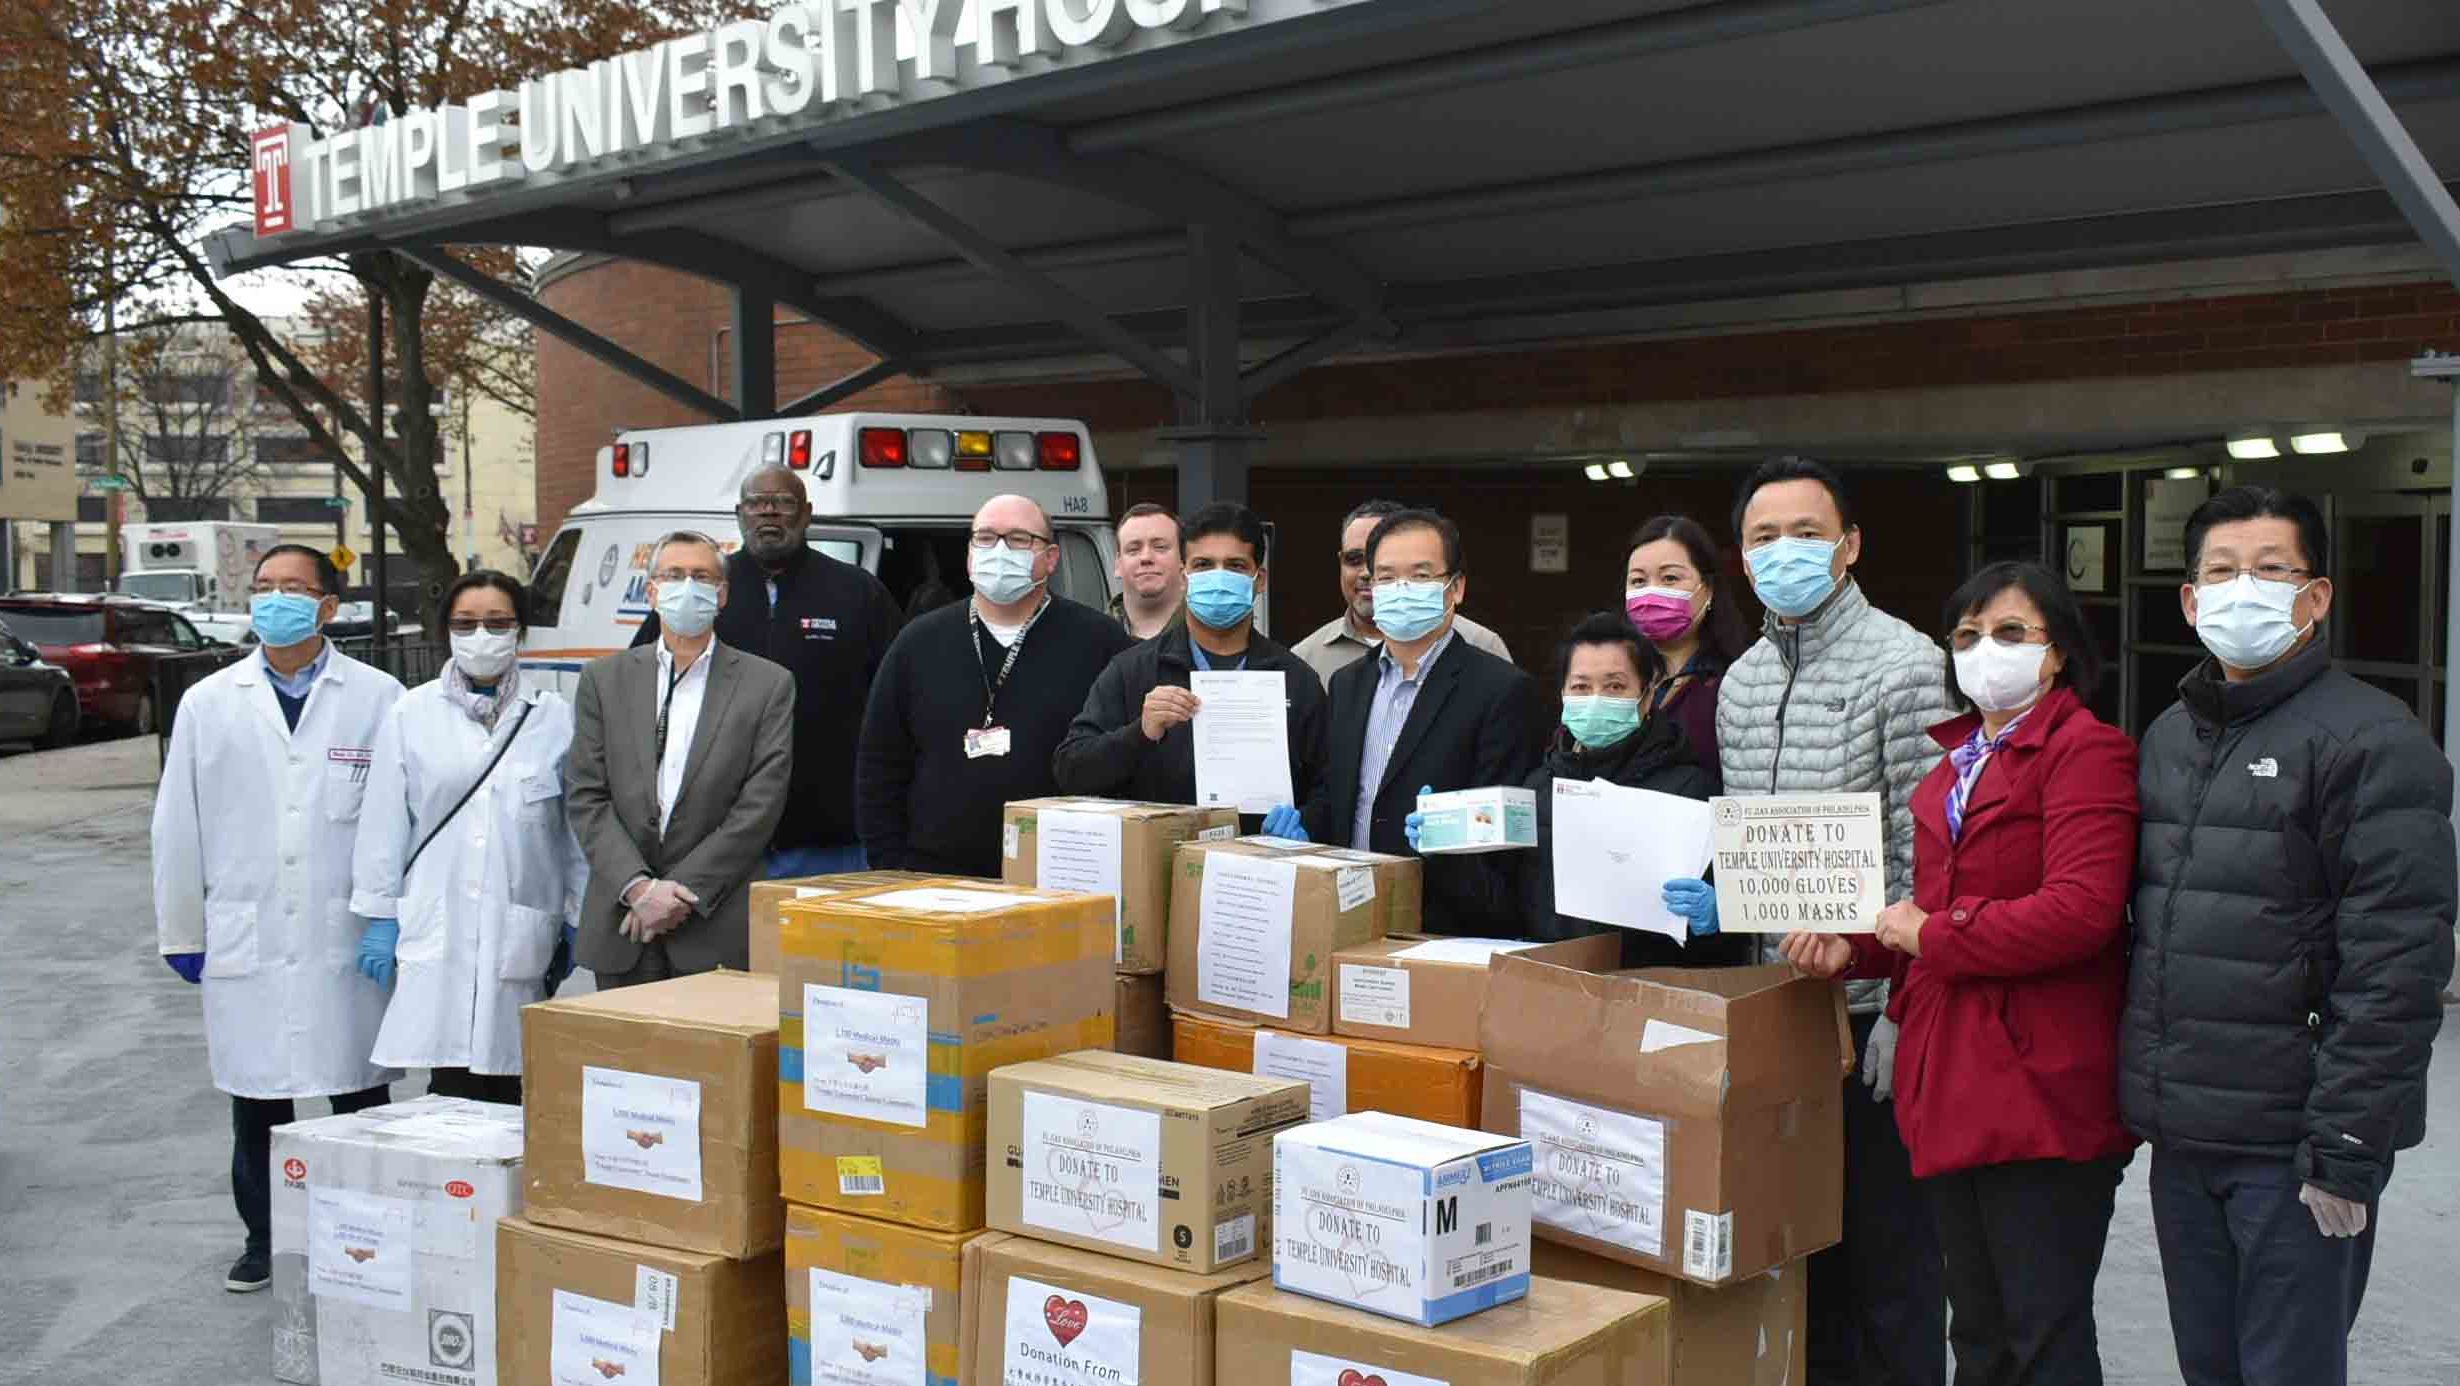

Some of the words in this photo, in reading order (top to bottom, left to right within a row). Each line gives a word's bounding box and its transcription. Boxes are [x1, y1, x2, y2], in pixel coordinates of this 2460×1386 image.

[302, 90, 512, 222] TEMPLE
[519, 0, 963, 172] UNIVERSITY
[1746, 824, 1815, 843] DONATE
[1824, 823, 1845, 842] TO
[1719, 851, 1758, 870] TEMPLE
[1761, 848, 1821, 870] UNIVERSITY
[1825, 849, 1876, 868] HOSPITAL
[1739, 877, 1789, 896] 10,000
[1795, 876, 1857, 894] GLOVES
[1743, 903, 1789, 921] 1,000
[1797, 902, 1858, 921] MASKS
[1059, 1155, 1101, 1180] DONATE
[1104, 1164, 1119, 1182] TO
[1558, 1153, 1602, 1183] DONATE
[1606, 1166, 1620, 1186] TO
[1030, 1181, 1059, 1203] TEMPLE
[1061, 1187, 1106, 1214] UNIVERSITY
[1107, 1197, 1147, 1222] HOSPITAL
[1436, 1196, 1457, 1235] M
[1532, 1178, 1556, 1200] EMPLE
[1560, 1183, 1606, 1214] UNIVERSITY
[1609, 1196, 1651, 1225] HOSPITAL
[1179, 1230, 1186, 1241] S
[1319, 1211, 1362, 1240] DONATE
[1366, 1223, 1380, 1244] TO
[1287, 1239, 1318, 1264] TEMPLE
[1320, 1247, 1369, 1277] UNIVERSITY
[1370, 1258, 1411, 1288] HOSPITAL
[1020, 1342, 1079, 1369] Donation
[1085, 1360, 1120, 1381] From
